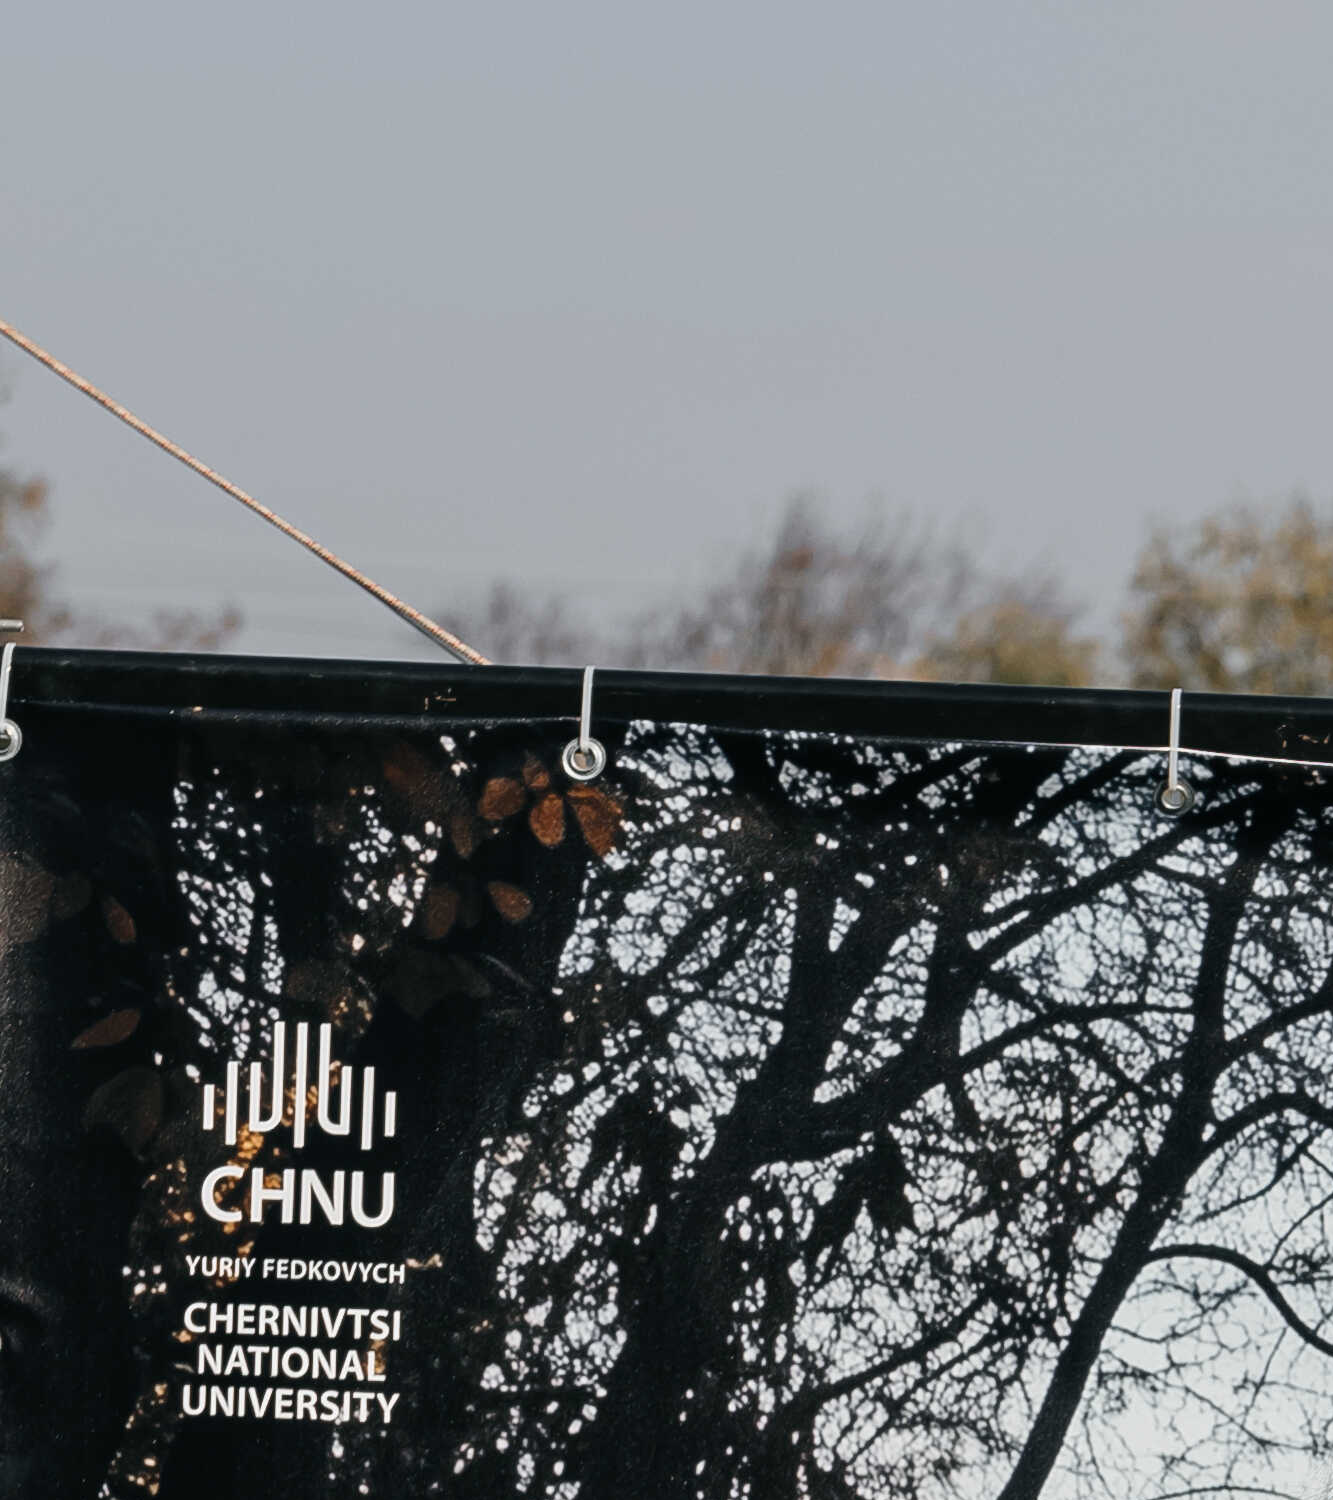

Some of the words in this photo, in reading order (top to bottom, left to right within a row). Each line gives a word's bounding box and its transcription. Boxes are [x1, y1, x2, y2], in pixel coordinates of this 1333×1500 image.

[201, 1166, 395, 1228] CHNU
[185, 1255, 256, 1278] YURIY
[262, 1258, 406, 1284] FEDKOVYCH
[183, 1302, 401, 1341] CHERNIVTSI
[197, 1344, 387, 1382] NATIONAL
[181, 1384, 400, 1424] UNIVERSITY
